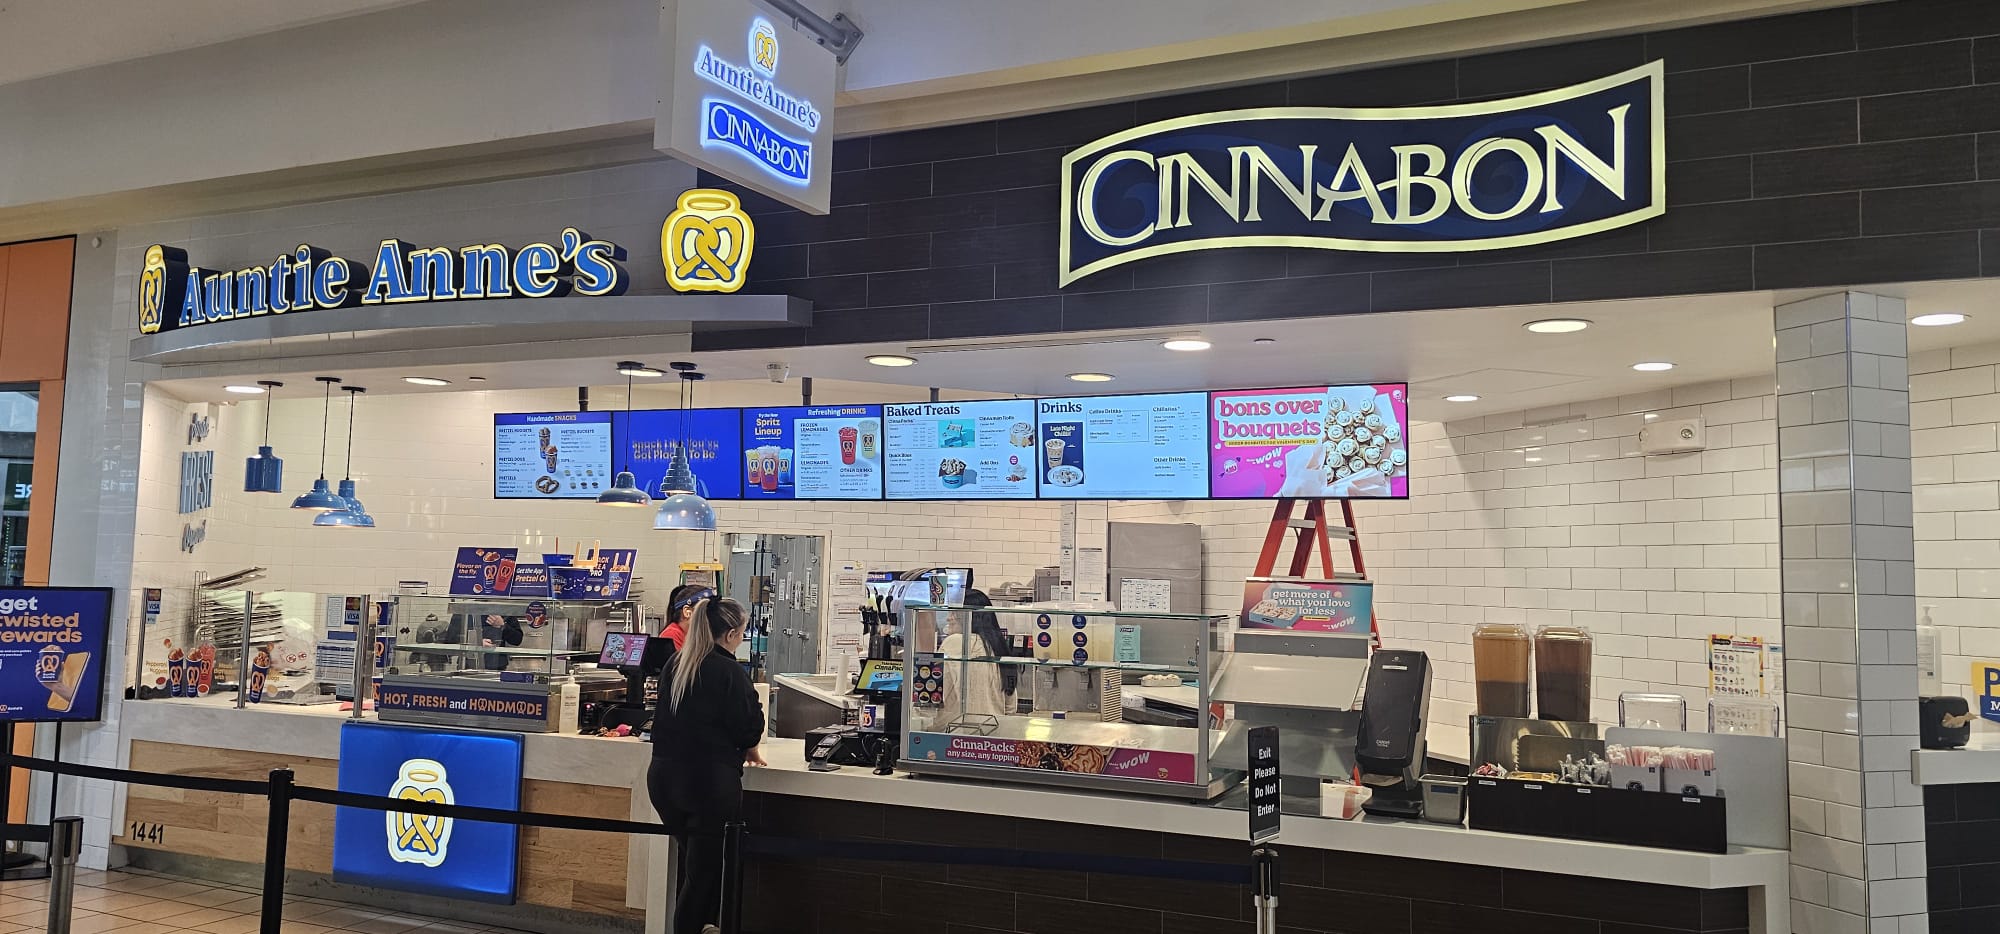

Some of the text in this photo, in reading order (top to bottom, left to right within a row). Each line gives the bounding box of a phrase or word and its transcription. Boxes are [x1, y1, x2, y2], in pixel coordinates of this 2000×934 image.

[699, 49, 818, 129] Auntie Anne's
[709, 104, 809, 176] CINNABON
[1077, 102, 1632, 247] CINNABON
[178, 226, 618, 328] Auntie Anne's
[807, 407, 867, 418] Refreshing DRINKS
[886, 405, 961, 417] Baked Treats
[1040, 401, 1083, 414] Drinks
[1219, 399, 1323, 417] bons over
[756, 418, 780, 428] Spritz
[1222, 419, 1322, 440] bouquets
[755, 427, 782, 437] Lineup
[634, 450, 651, 459] Got
[689, 450, 701, 459] To
[702, 450, 715, 459] Be
[1255, 447, 1283, 465] WOW
[181, 450, 214, 514] FRESH
[533, 567, 544, 576] App
[590, 569, 603, 577] PRO
[515, 574, 540, 584] Pretzel
[1272, 591, 1289, 600] get
[1319, 590, 1331, 599] of
[0, 597, 38, 615] get
[1278, 597, 1351, 608] what you love
[347, 612, 360, 620] VISA
[1298, 606, 1336, 616] for less
[1330, 616, 1357, 630] WOW
[0, 628, 83, 644] ewards
[874, 664, 904, 672] CinnaPac
[384, 692, 412, 709] HOT,
[412, 694, 448, 708] FRESH
[450, 699, 467, 710] and
[952, 737, 1015, 754] CinnaPacks
[947, 749, 1020, 764] any size, any topping
[1258, 746, 1272, 760] Exit
[1119, 751, 1151, 770] WOW
[1254, 766, 1276, 780] Please
[1254, 783, 1276, 799] Do Not
[1257, 803, 1275, 817] Enter
[131, 821, 163, 844] 1441
